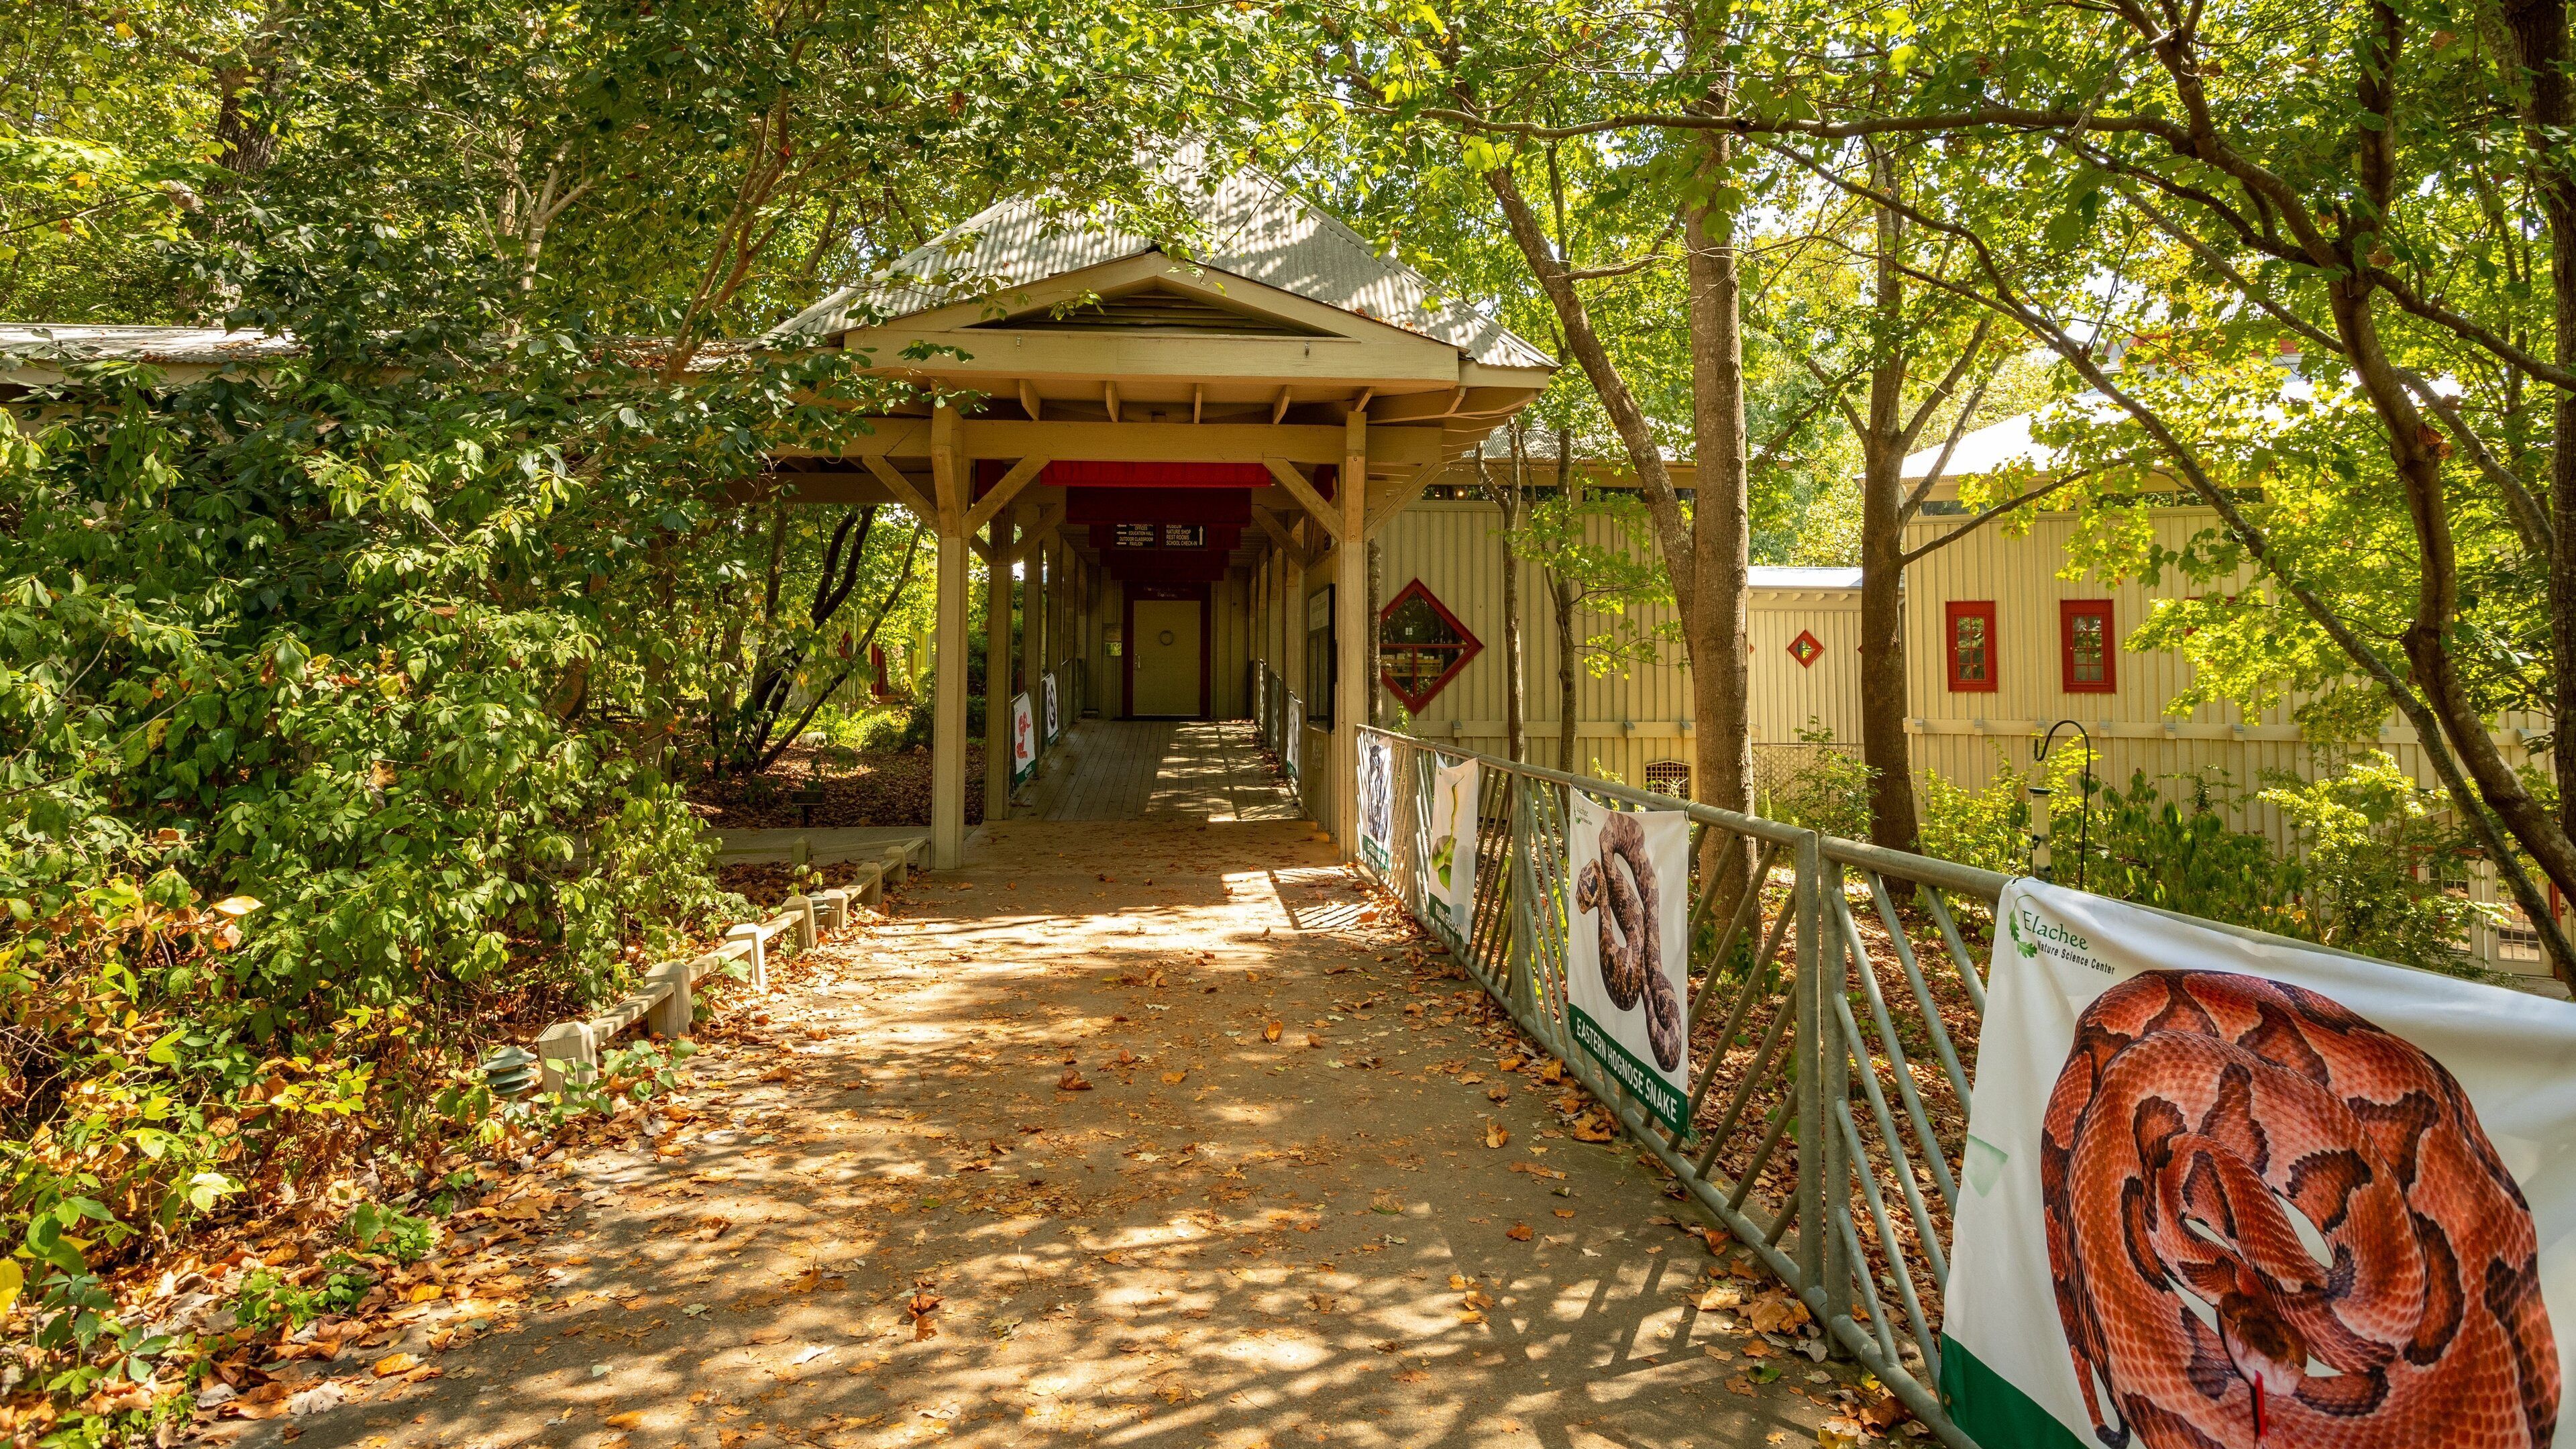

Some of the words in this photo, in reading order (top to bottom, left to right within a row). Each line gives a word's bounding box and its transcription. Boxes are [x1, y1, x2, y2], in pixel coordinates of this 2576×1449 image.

[2022, 910, 2088, 951] Elachee
[2037, 940, 2059, 956] Nature
[2061, 949, 2088, 967] Science
[2091, 958, 2114, 975] Center
[1576, 1016, 1607, 1061] EASTERN
[1607, 1044, 1644, 1095] HOGNOSE
[1645, 1077, 1677, 1124] SNAKE
